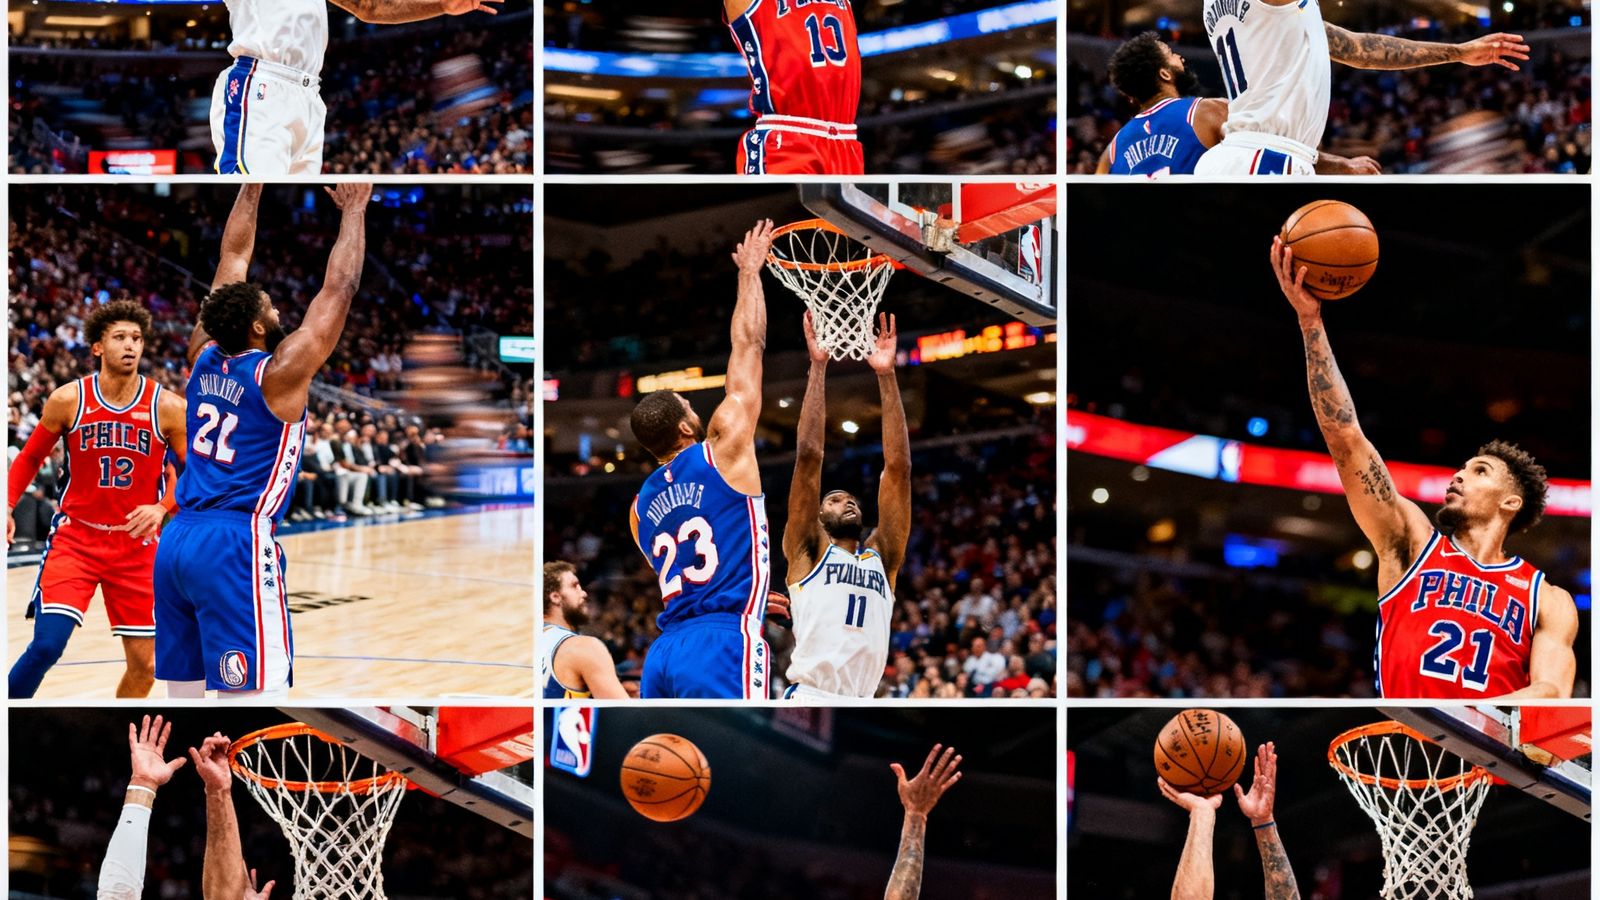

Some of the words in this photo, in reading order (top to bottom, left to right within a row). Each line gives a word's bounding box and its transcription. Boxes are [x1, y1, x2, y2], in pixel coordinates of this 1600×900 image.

[1216, 27, 1248, 100] 11
[652, 516, 719, 602] 23
[845, 593, 867, 628] 11
[1410, 568, 1526, 645] PHILA
[1420, 619, 1496, 692] 21
